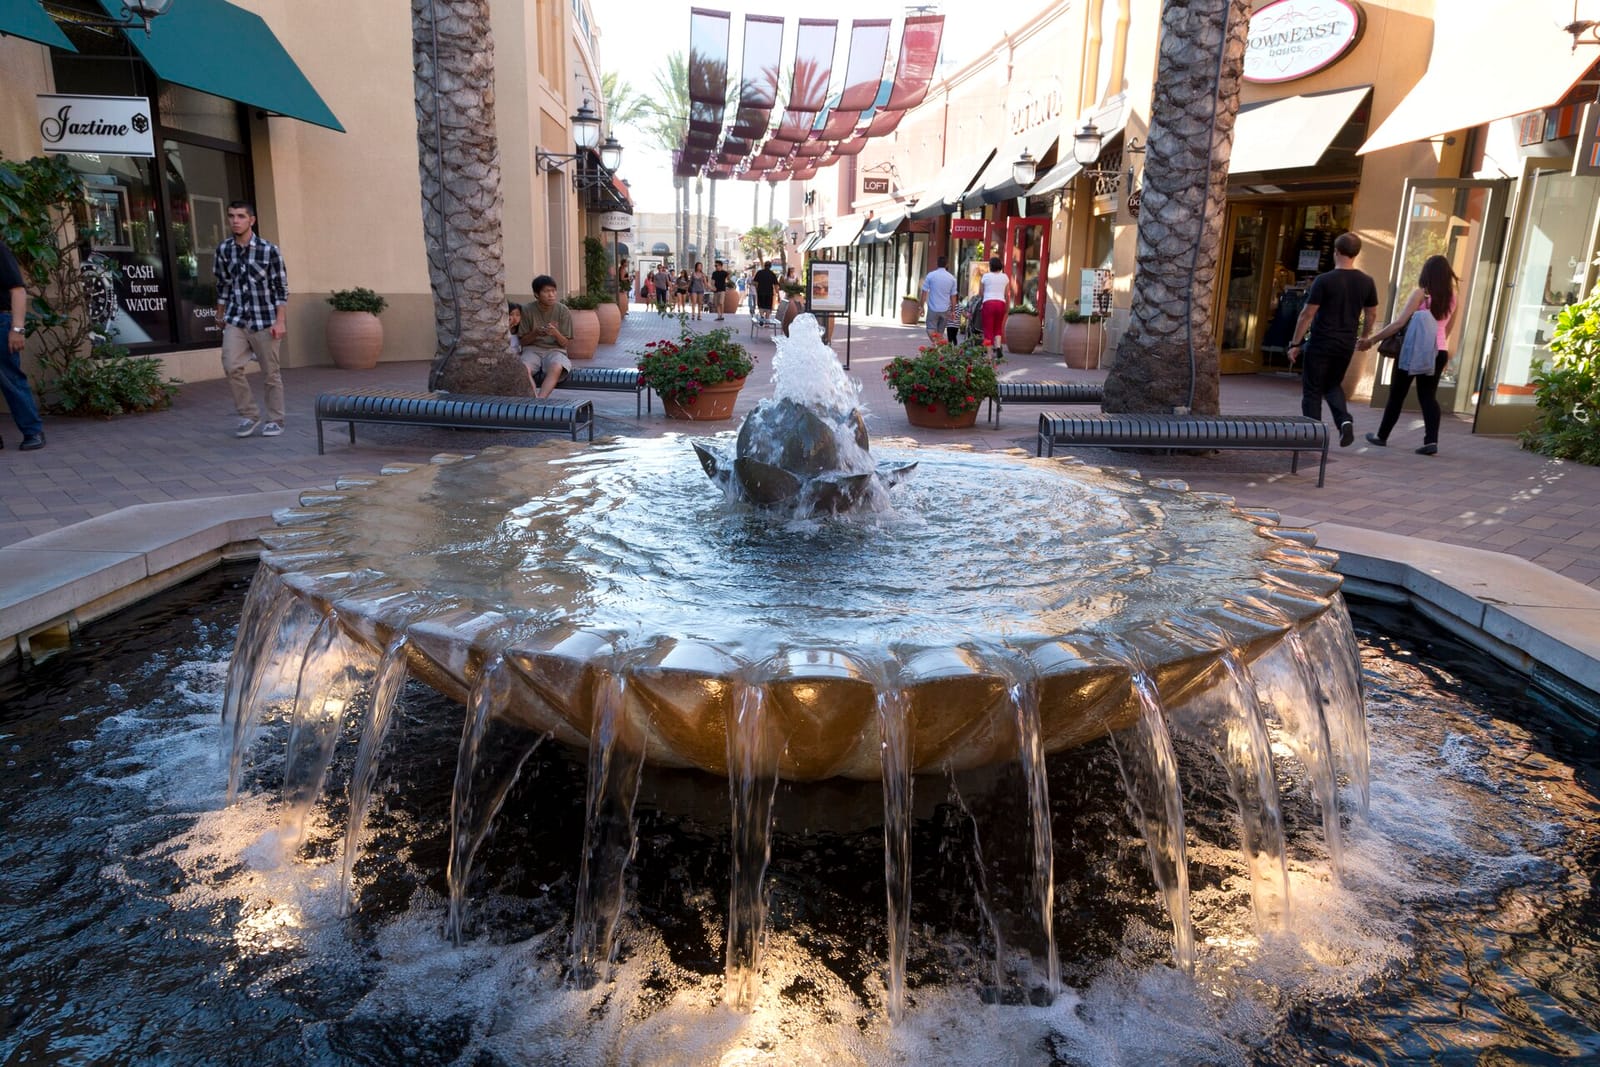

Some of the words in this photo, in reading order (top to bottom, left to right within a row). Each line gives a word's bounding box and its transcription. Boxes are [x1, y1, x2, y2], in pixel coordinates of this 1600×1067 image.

[41, 105, 129, 143] Jaztime
[864, 181, 887, 190] LOFT
[131, 281, 141, 293] for
[142, 284, 159, 296] your
